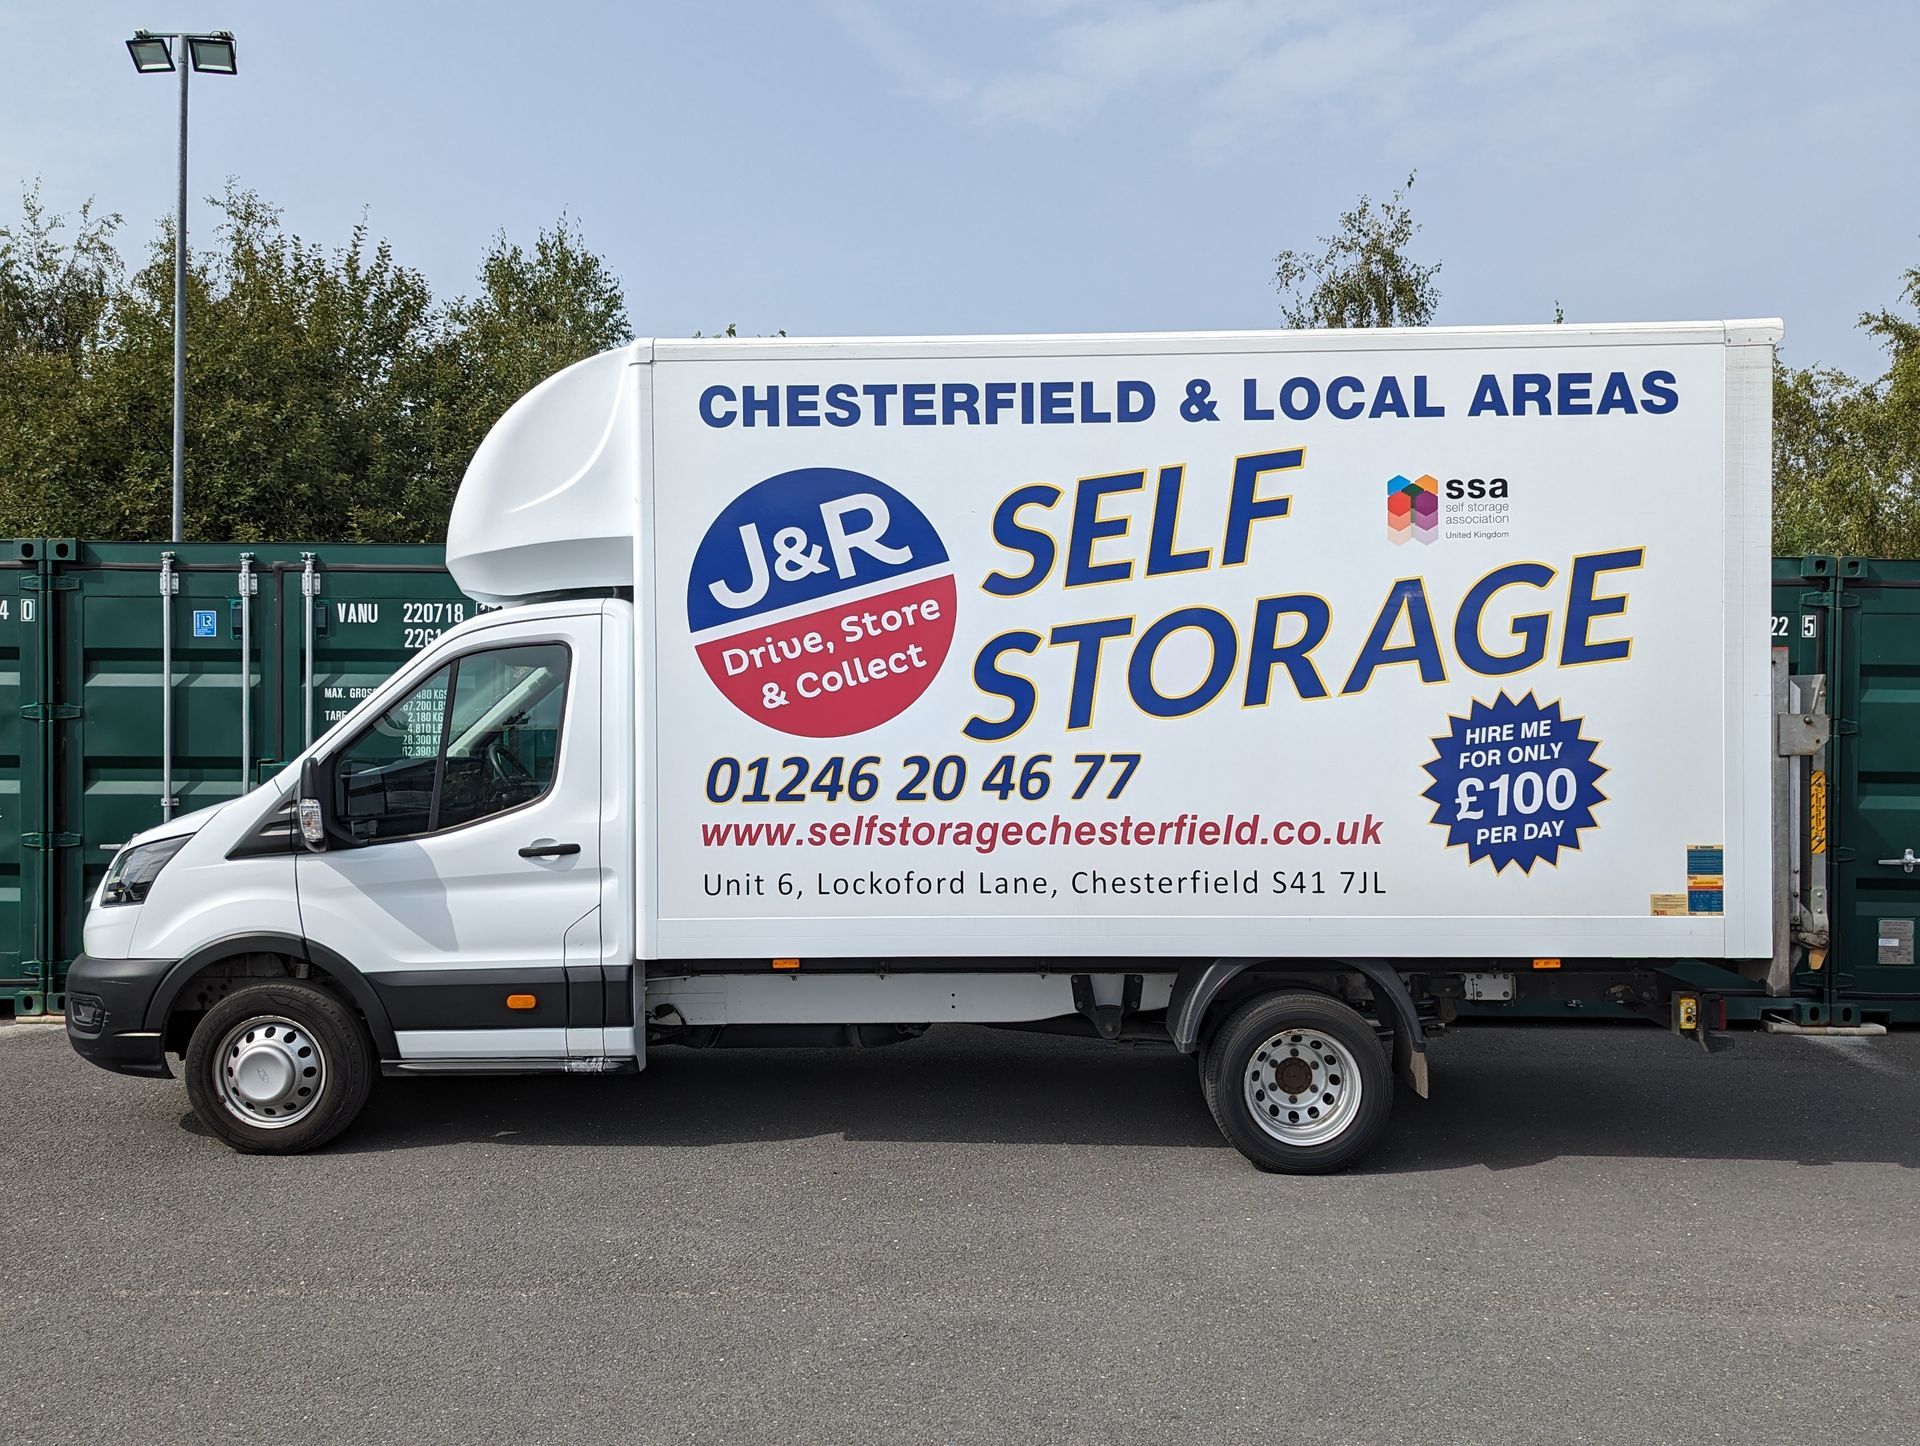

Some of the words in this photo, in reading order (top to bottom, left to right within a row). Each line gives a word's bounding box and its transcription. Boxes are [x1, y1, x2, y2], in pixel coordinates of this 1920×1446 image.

[698, 379, 1156, 429] CHESTERFIELD
[1178, 378, 1221, 423] &
[1243, 374, 1446, 421] LOCAL
[1467, 369, 1680, 417] AREAS
[1445, 478, 1509, 500] ssa
[1445, 502, 1465, 513] self
[1467, 502, 1509, 514] storage
[1445, 513, 1510, 525] association
[979, 445, 1307, 599] SELF
[1445, 531, 1472, 540] United
[1473, 531, 1510, 541] Kingdom
[708, 492, 914, 610] J&R
[337, 603, 379, 623] VANU
[403, 603, 464, 623] 220718
[721, 631, 835, 677] Drive,
[840, 598, 941, 643] Store
[1803, 616, 1815, 636] 5
[959, 545, 1647, 744] STORAGE
[761, 682, 790, 709] &
[796, 643, 928, 699] Collect
[324, 688, 346, 699] MAX.
[350, 688, 376, 699] GROS
[433, 700, 446, 711] LB
[407, 723, 431, 734] 4.810
[408, 712, 431, 722] 2.180
[432, 712, 444, 722] KG
[1465, 724, 1514, 745] HIRE
[1521, 720, 1552, 739] ME
[1459, 749, 1501, 769] FOR
[1507, 741, 1563, 764] ONLY
[705, 754, 881, 804] 01246
[895, 753, 969, 803] 20
[981, 752, 1054, 803] 46
[1070, 752, 1144, 801] 77
[1455, 767, 1577, 821] £100
[701, 813, 1385, 855] www.selfstoragechesterfield.co.uk
[1476, 825, 1517, 845] PER
[1523, 820, 1565, 840] DAY
[704, 872, 765, 896] Unit
[778, 873, 803, 900] 6,
[818, 870, 965, 895] Lockoford
[979, 871, 1058, 899] Lane,
[1071, 869, 1259, 894] Chesterfield
[1272, 871, 1326, 894] S41
[1340, 871, 1387, 894] 7JL
